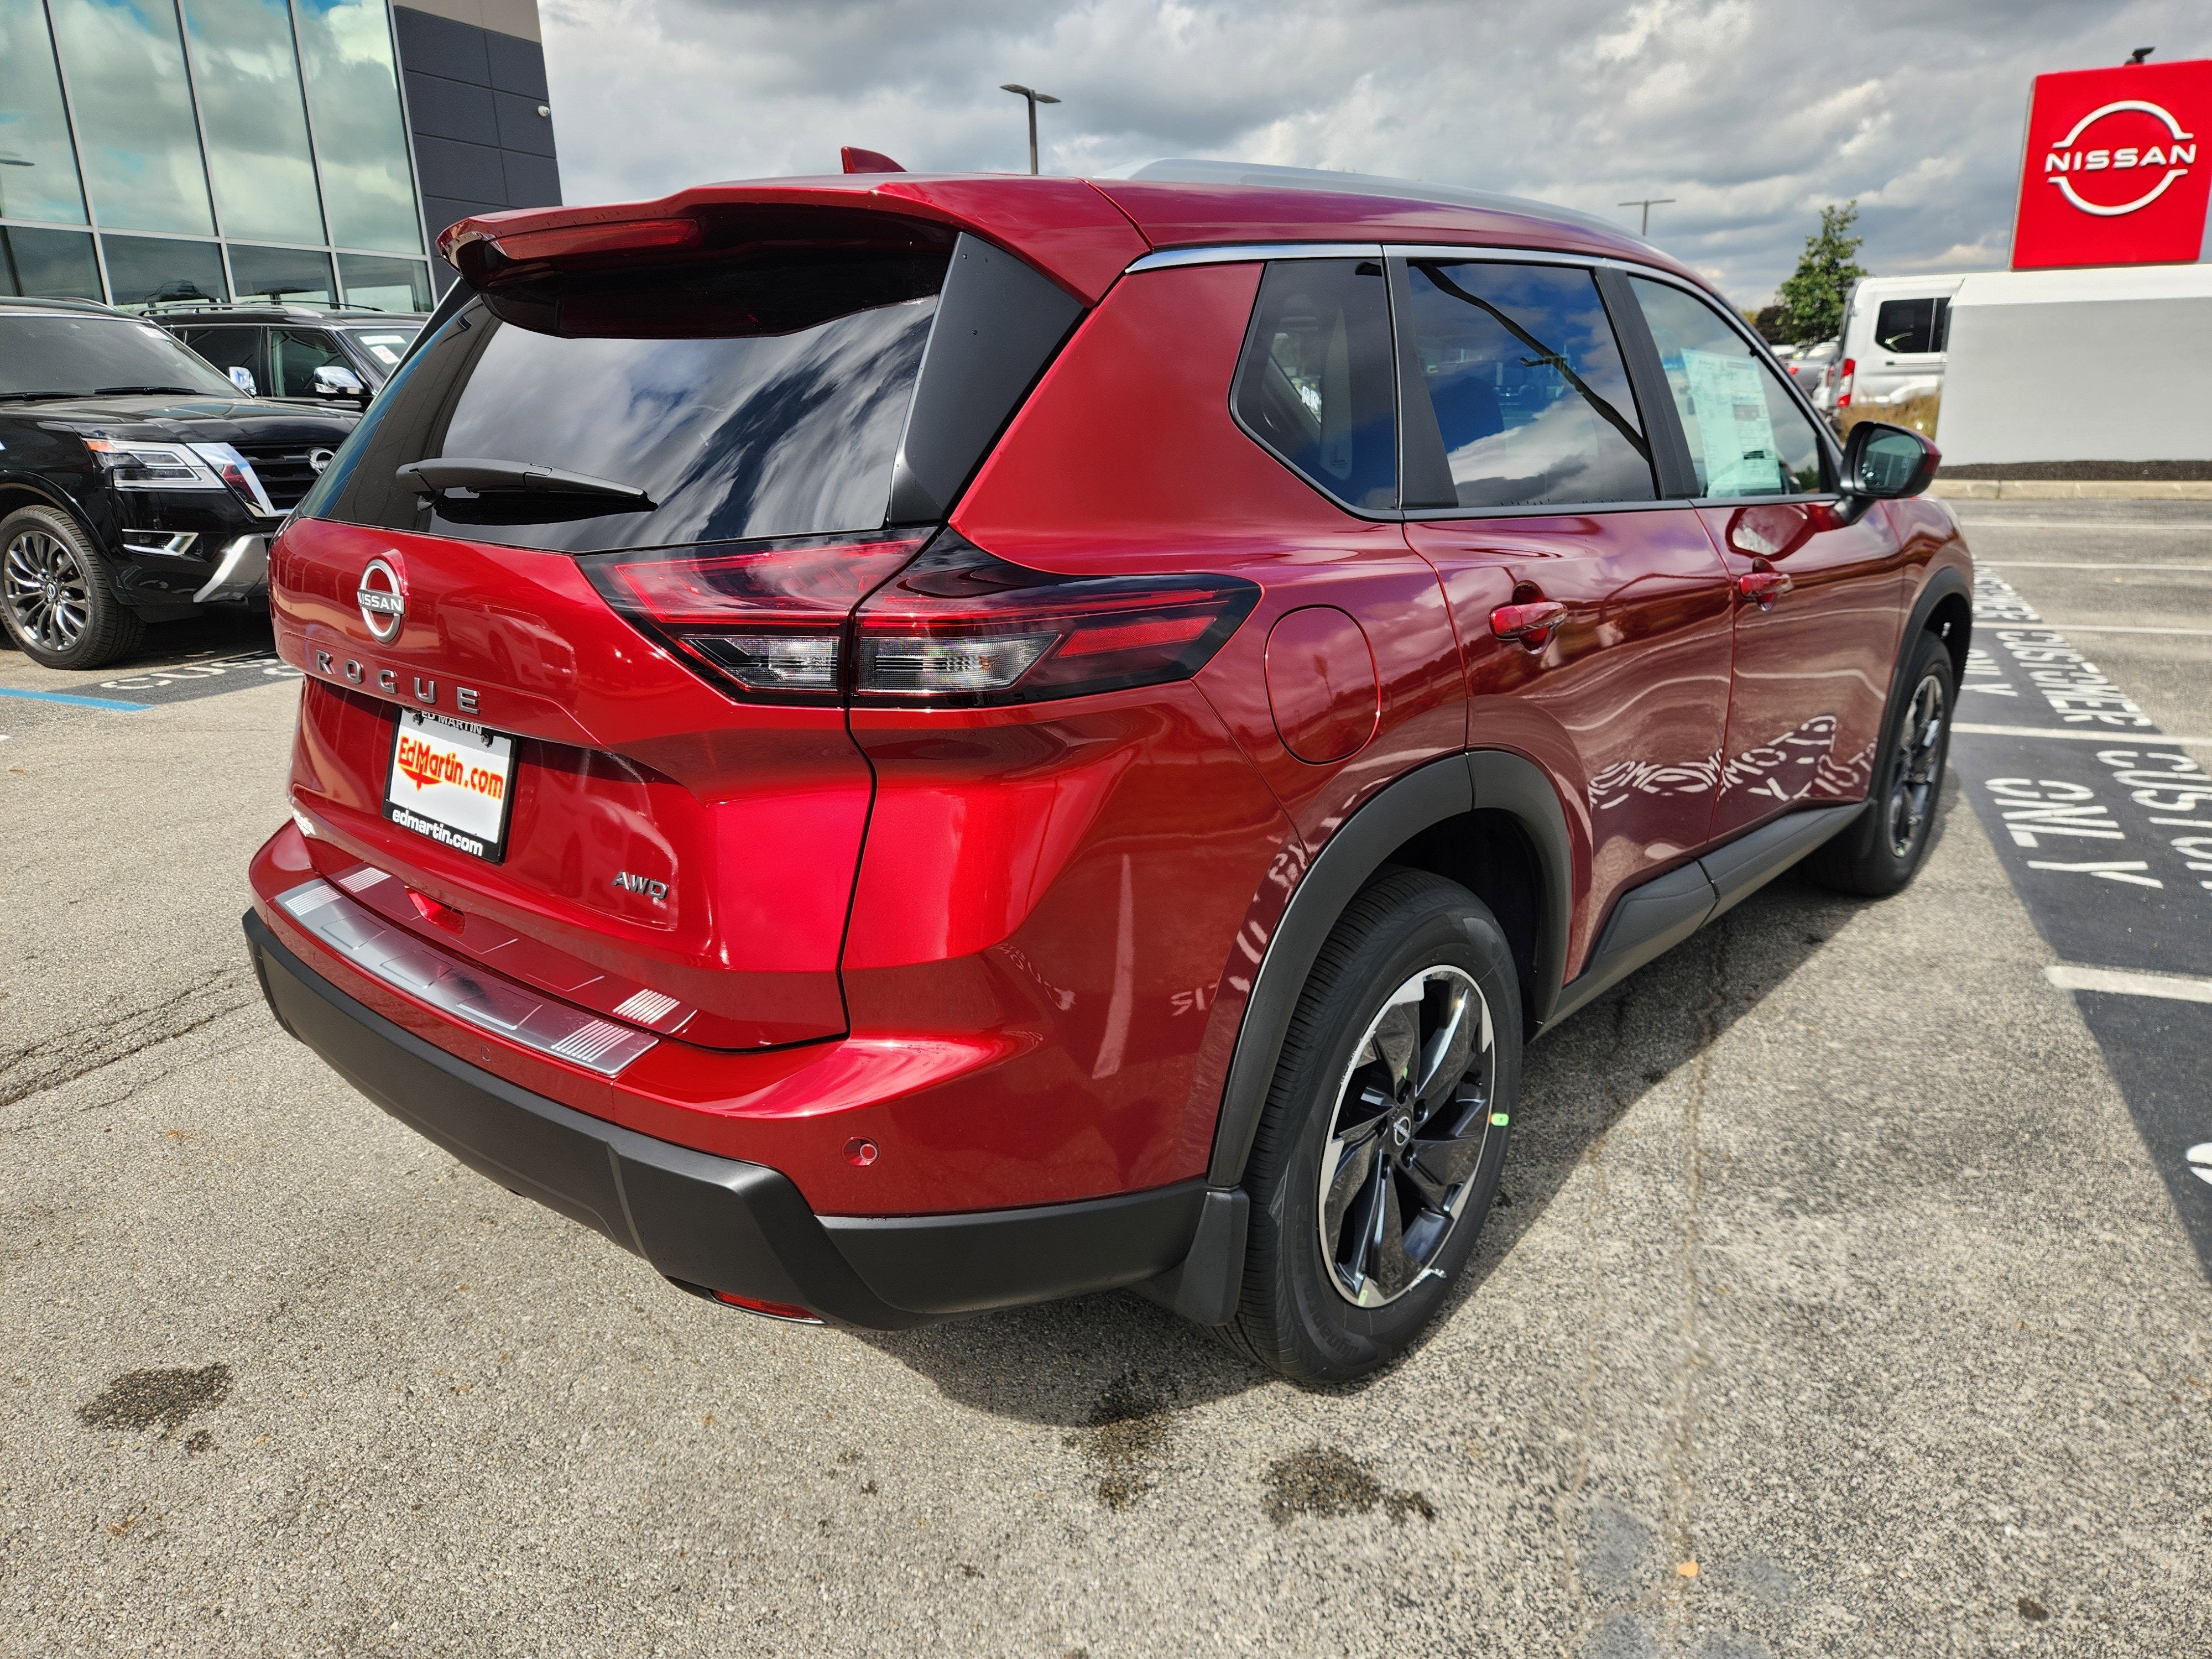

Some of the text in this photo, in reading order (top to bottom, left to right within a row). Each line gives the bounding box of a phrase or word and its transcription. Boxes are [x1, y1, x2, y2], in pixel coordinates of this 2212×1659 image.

[2044, 143, 2197, 173] NISSAN
[358, 591, 403, 611] NISSAN
[315, 649, 480, 715] ROGUE
[1995, 630, 2152, 726] CUSTOMER
[438, 716, 482, 735] MARTIN
[398, 736, 504, 800] EdMartin.com
[392, 808, 483, 857] edmartin.com
[1985, 778, 2164, 889] ONLY
[612, 870, 667, 900] AWD
